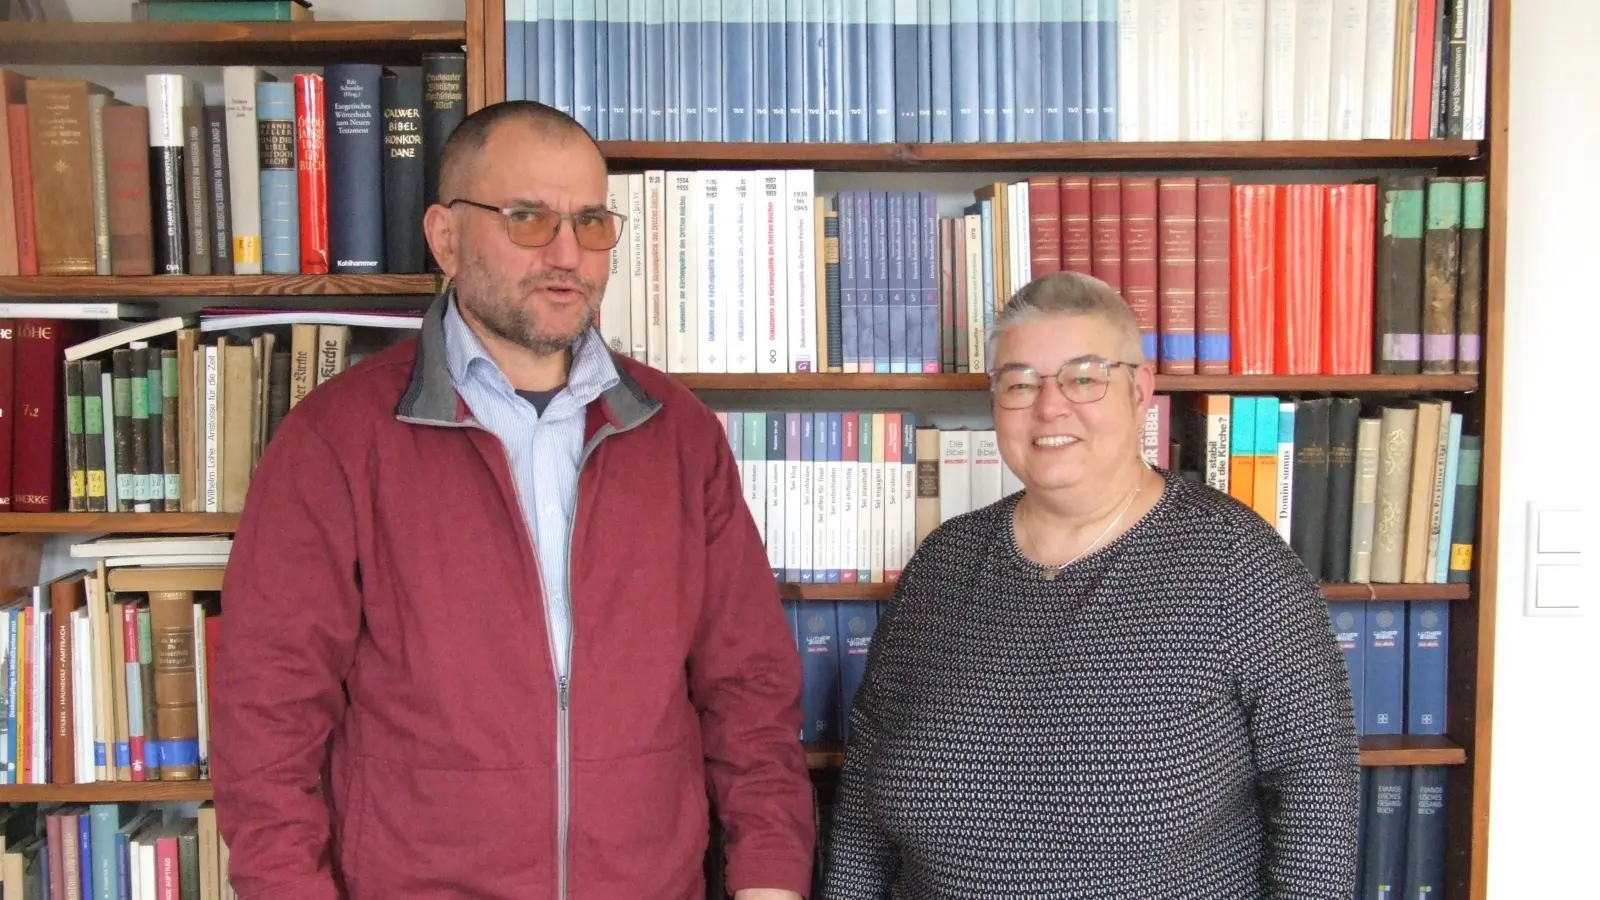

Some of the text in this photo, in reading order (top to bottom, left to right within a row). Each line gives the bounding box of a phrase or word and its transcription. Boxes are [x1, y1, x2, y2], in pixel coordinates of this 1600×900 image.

[335, 103, 371, 111] Exegetisches
[384, 108, 420, 118] CALWER
[1452, 97, 1461, 117] Ingrid
[385, 135, 421, 145] KONKOR
[391, 148, 415, 158] DANZ
[767, 257, 775, 296] Kirchenpolitik
[911, 294, 916, 302] 5
[768, 307, 776, 340] Dokumente
[17, 326, 52, 340] LÖHE
[294, 351, 308, 383] Kirche
[321, 340, 339, 378] Kirche
[208, 373, 216, 386] die
[1145, 405, 1158, 446] BIBEL
[949, 440, 963, 448] Die
[1219, 417, 1227, 460] Kirche?
[1209, 441, 1217, 469] stabil
[790, 466, 798, 490] Sei klug
[1218, 462, 1226, 478] die
[207, 471, 216, 505] Wilhelm
[15, 495, 48, 504] WERKE
[845, 502, 853, 512] Sei
[1279, 480, 1289, 519] Domini
